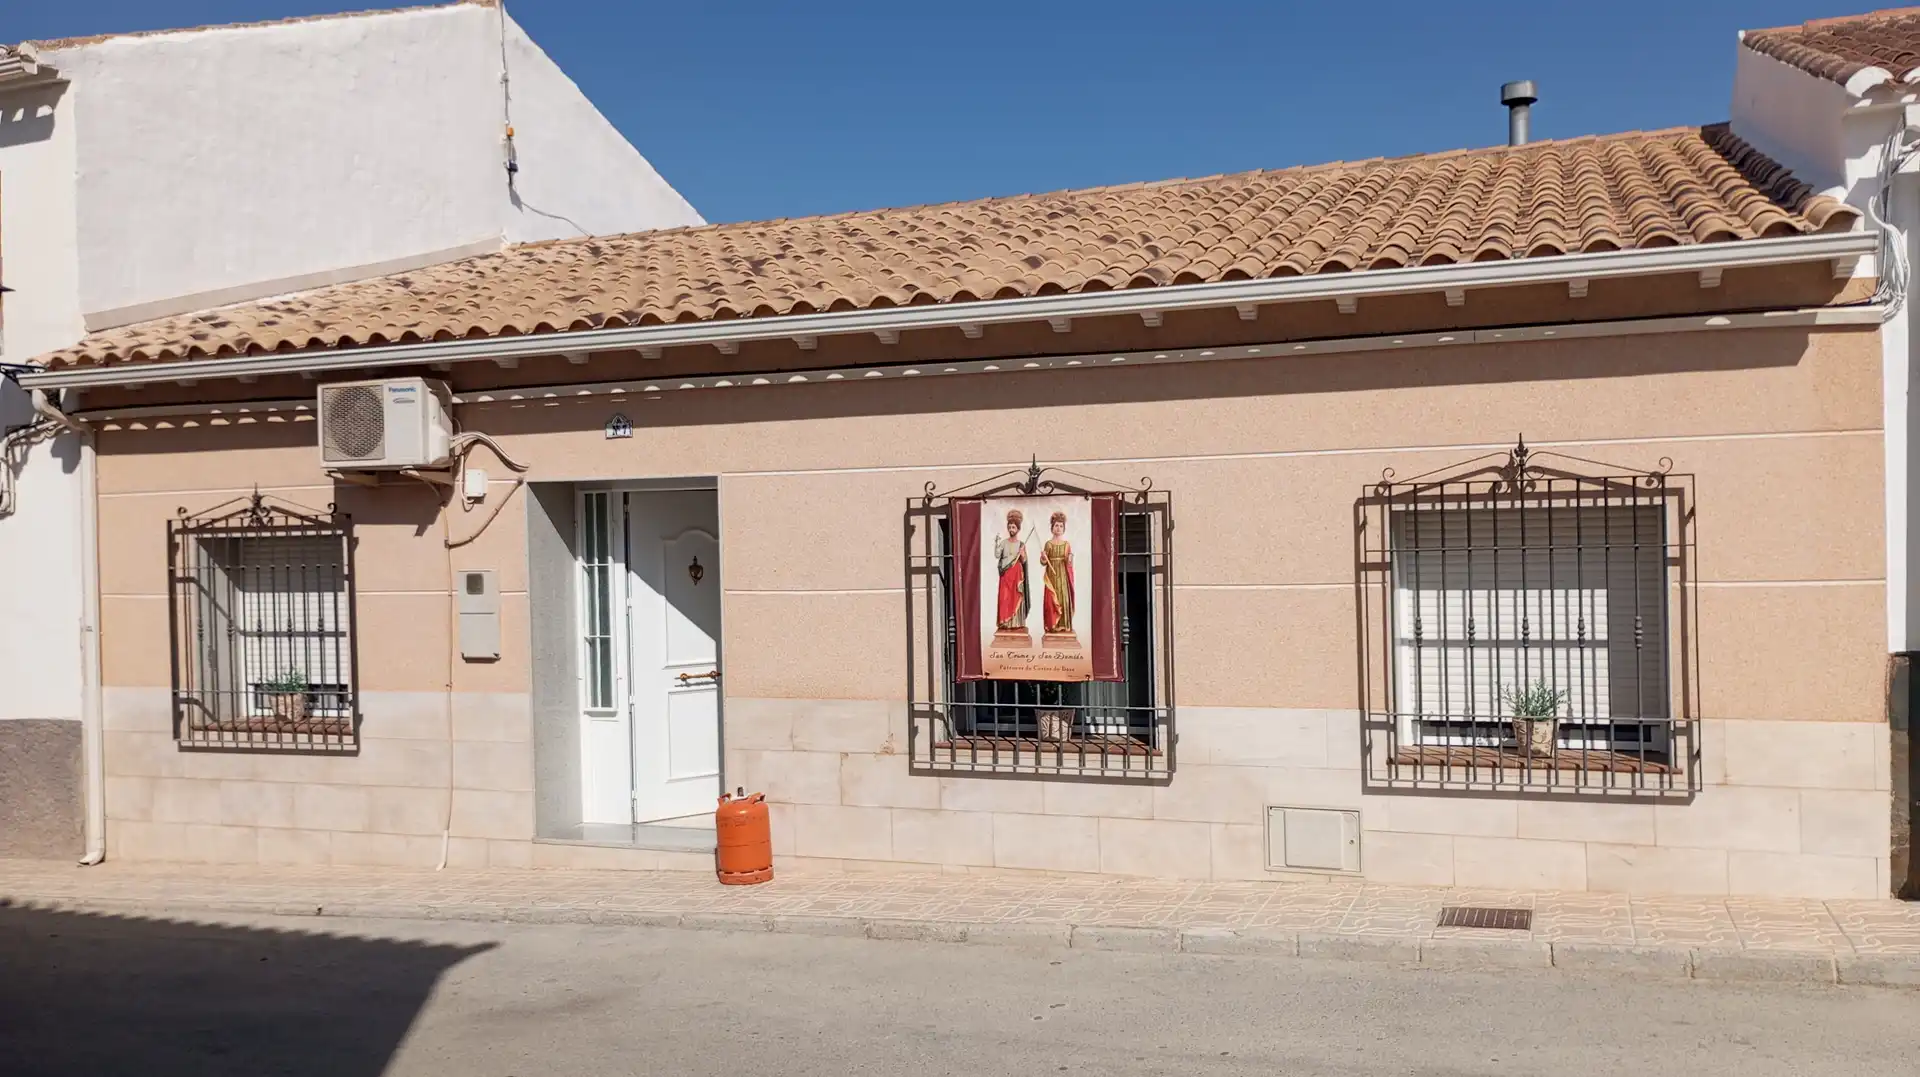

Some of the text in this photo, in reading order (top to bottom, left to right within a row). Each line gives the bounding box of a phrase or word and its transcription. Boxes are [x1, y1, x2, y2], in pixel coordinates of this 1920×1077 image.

[989, 651, 1004, 659] San
[1006, 651, 1029, 659] Cosme
[1026, 654, 1036, 663] y
[1038, 651, 1052, 659] San
